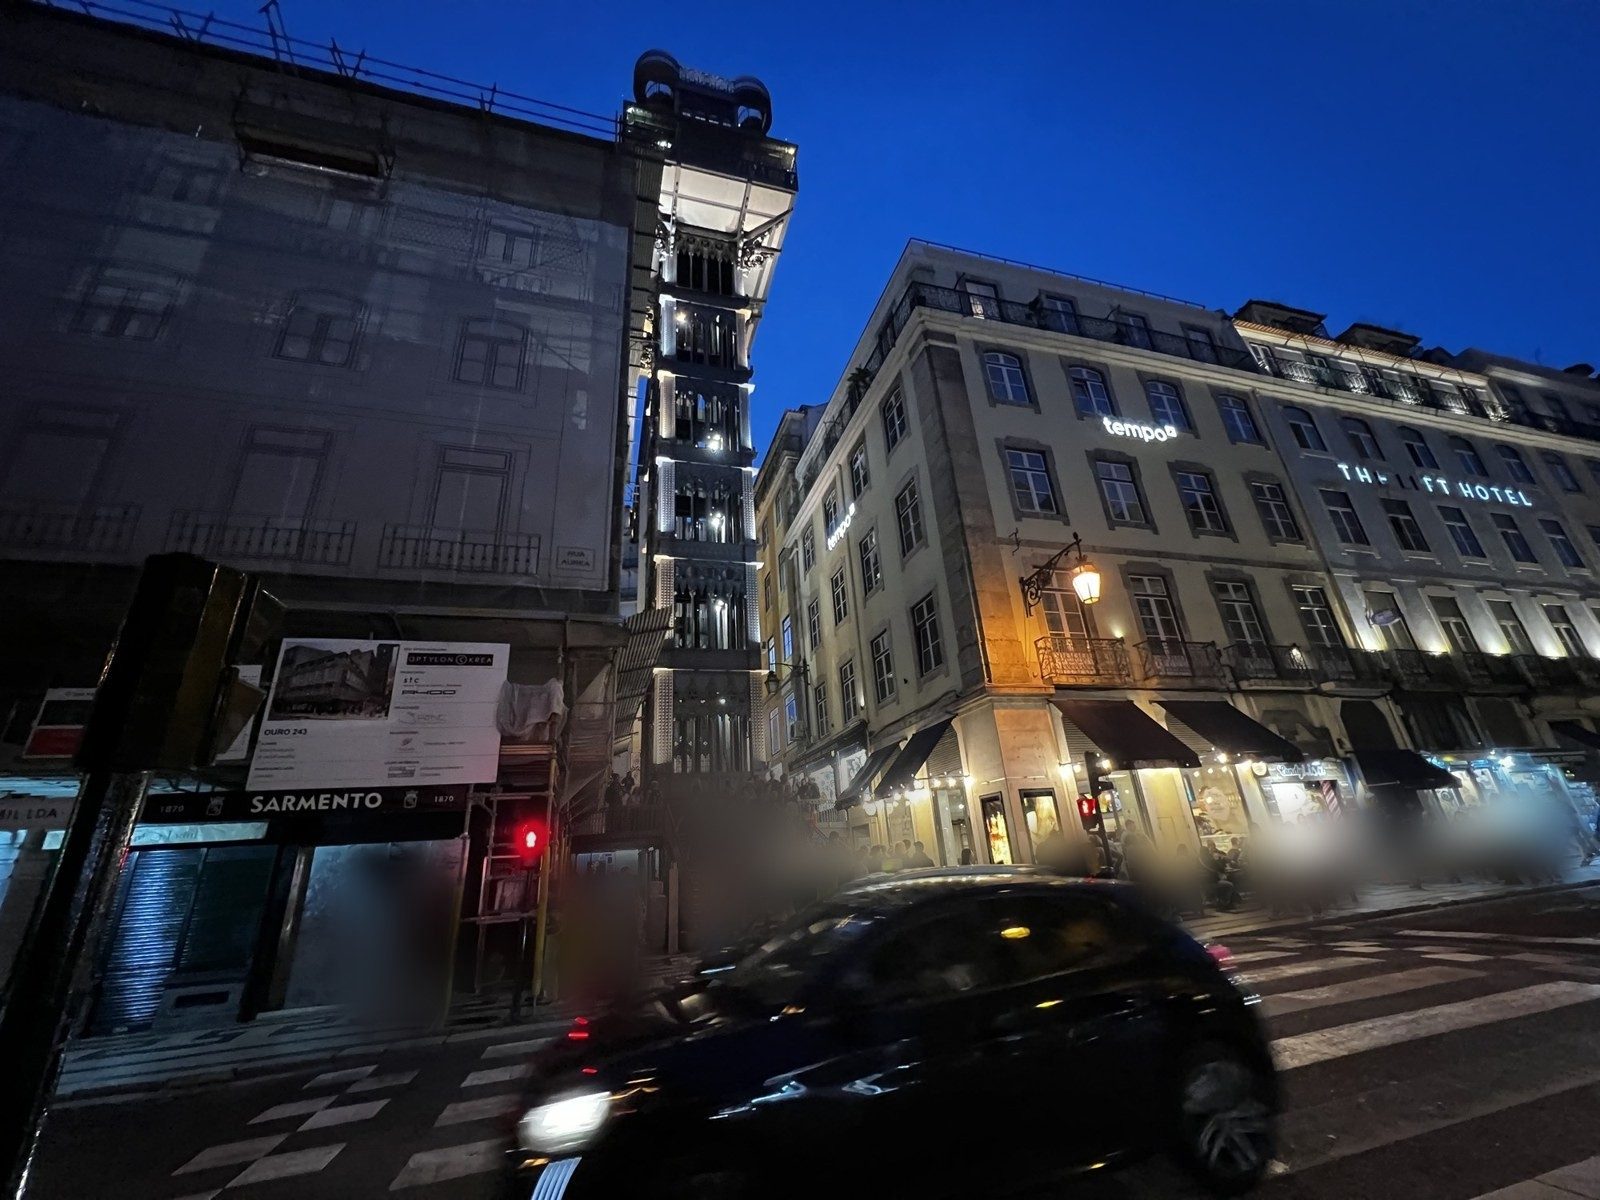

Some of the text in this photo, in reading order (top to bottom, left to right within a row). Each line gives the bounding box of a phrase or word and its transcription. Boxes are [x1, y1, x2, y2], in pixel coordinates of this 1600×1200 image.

[1103, 417, 1168, 442] tempo
[1337, 463, 1388, 486] THE
[1458, 482, 1533, 507] HOTEL
[828, 513, 852, 551] tempo
[264, 728, 308, 736] OURO 243
[161, 792, 454, 813] 1870 SARMENTO 1870
